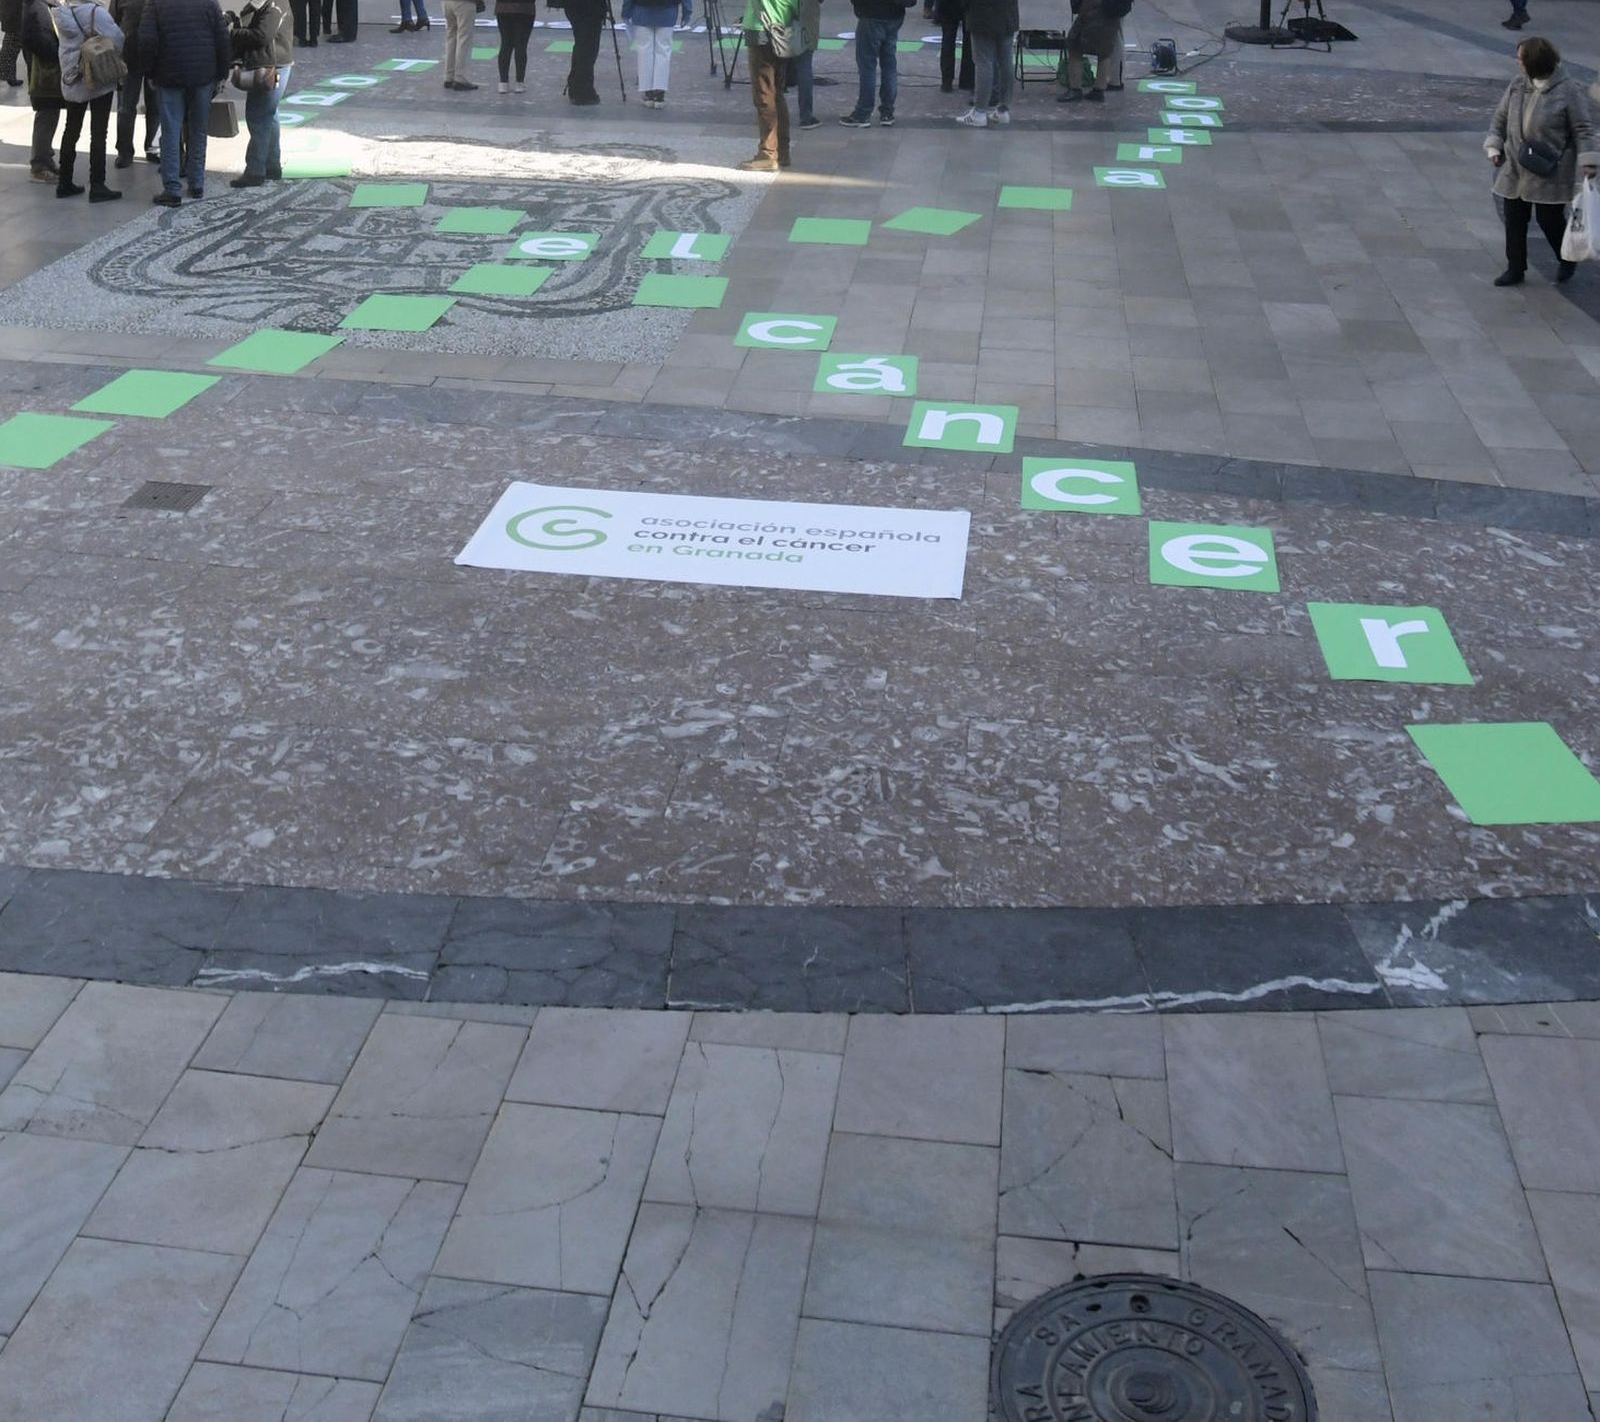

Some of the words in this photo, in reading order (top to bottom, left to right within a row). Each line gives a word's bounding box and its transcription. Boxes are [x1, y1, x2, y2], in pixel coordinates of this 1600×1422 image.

[633, 529, 729, 545] contra
[737, 535, 764, 546] el
[772, 537, 877, 553] cáncer
[640, 515, 796, 534] asociación
[808, 526, 941, 544] española
[626, 542, 662, 554] en
[672, 544, 804, 563] Granada
